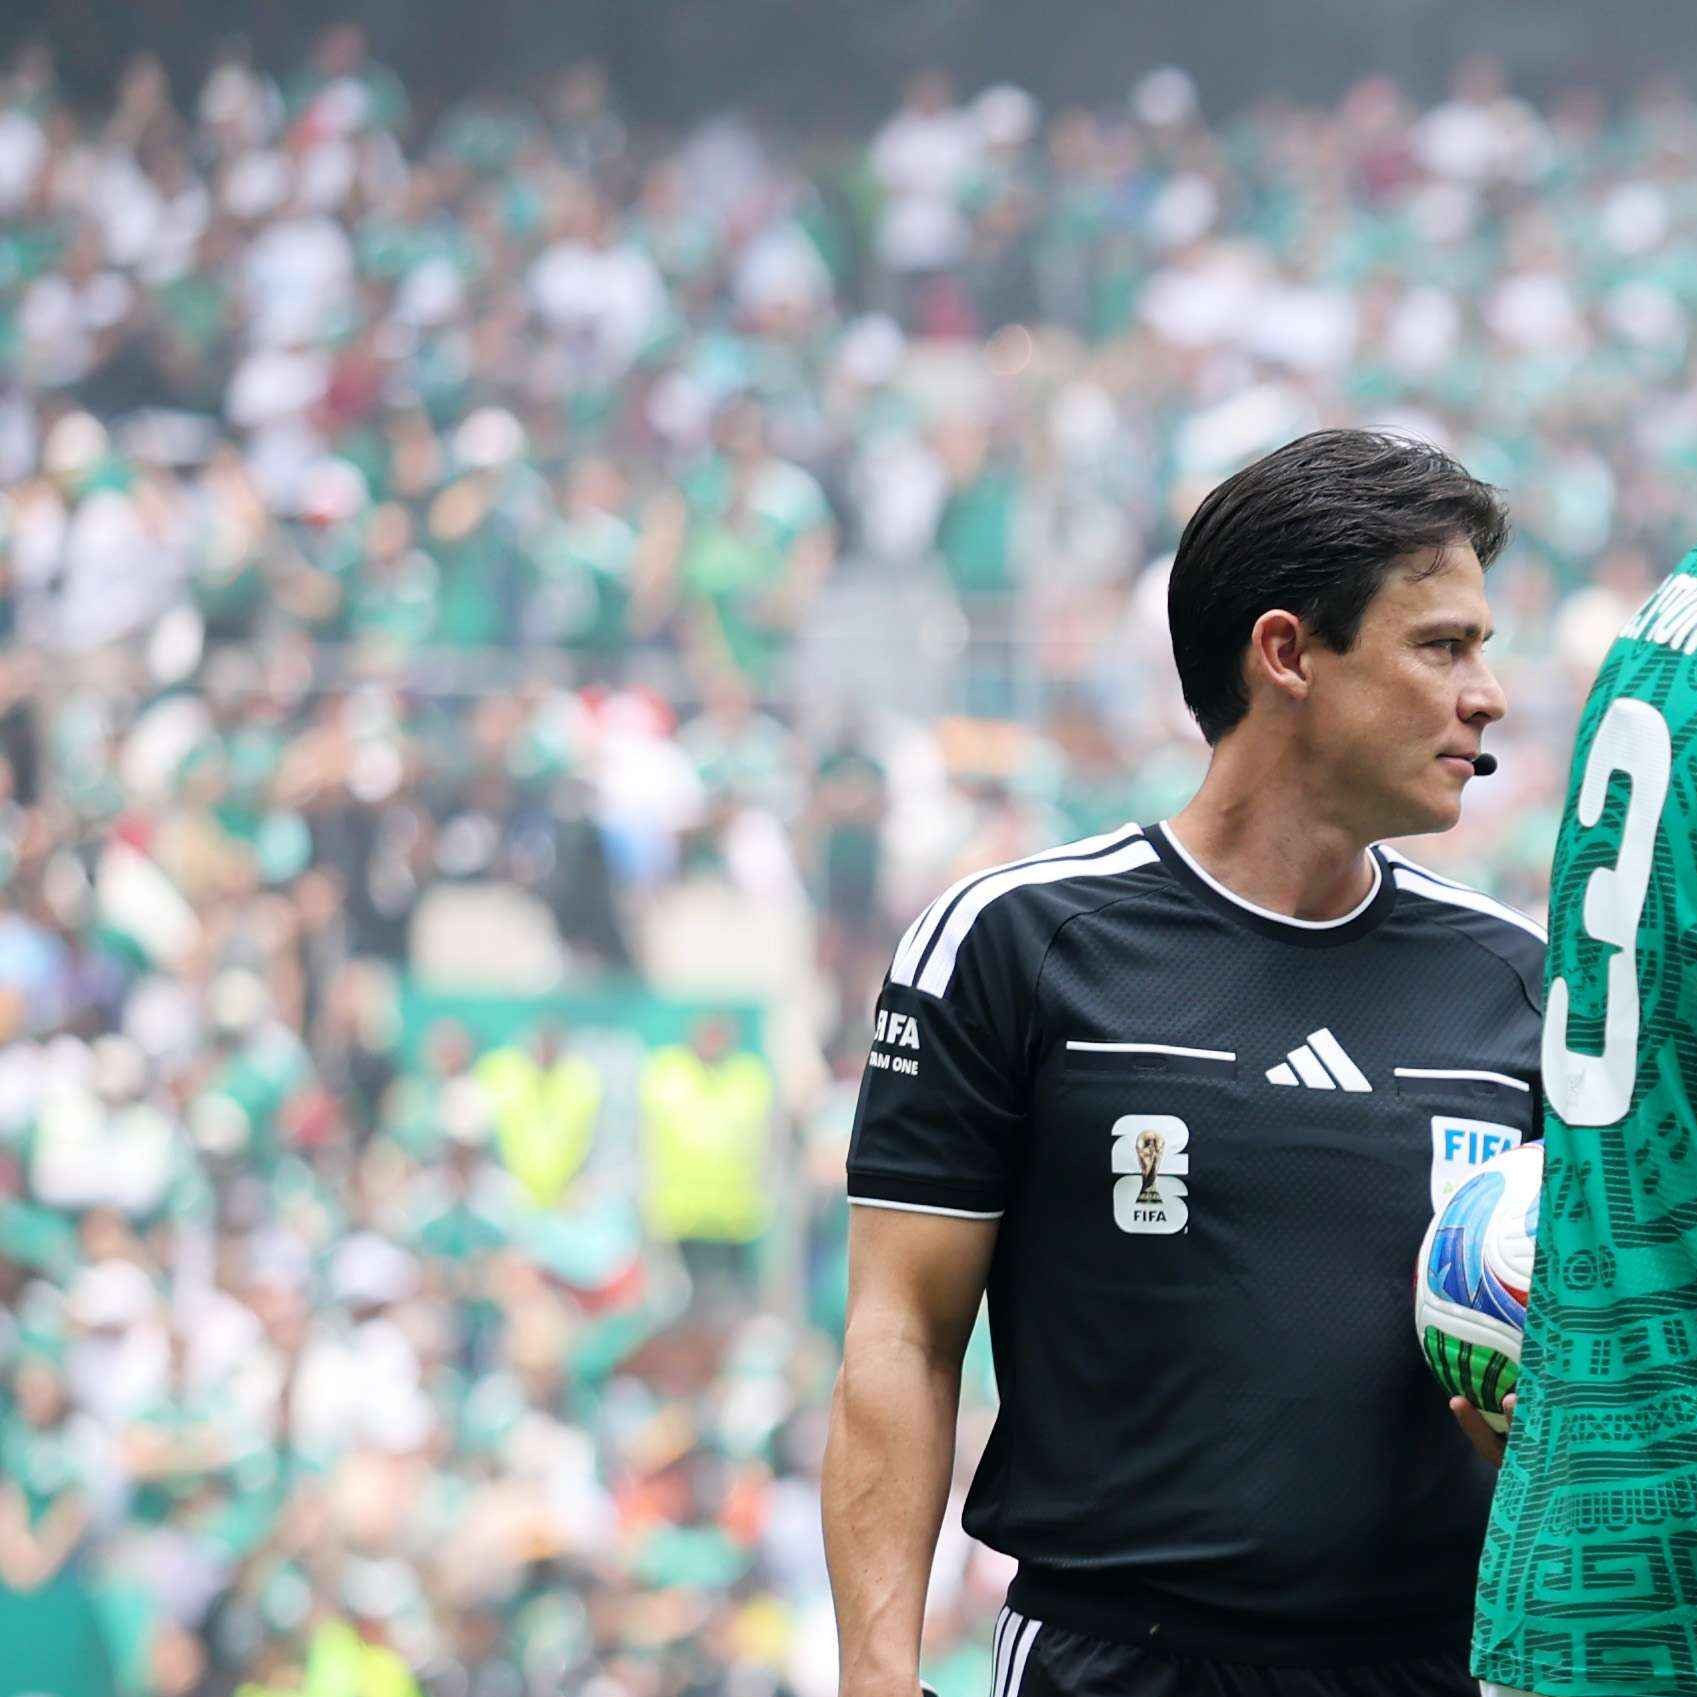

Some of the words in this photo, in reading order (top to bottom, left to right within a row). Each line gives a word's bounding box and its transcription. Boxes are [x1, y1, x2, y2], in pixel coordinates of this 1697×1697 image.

[1541, 697, 1672, 1127] 3
[873, 1009, 920, 1050] IFA
[892, 1056, 919, 1076] ONE
[1133, 1210, 1167, 1222] FIFA
